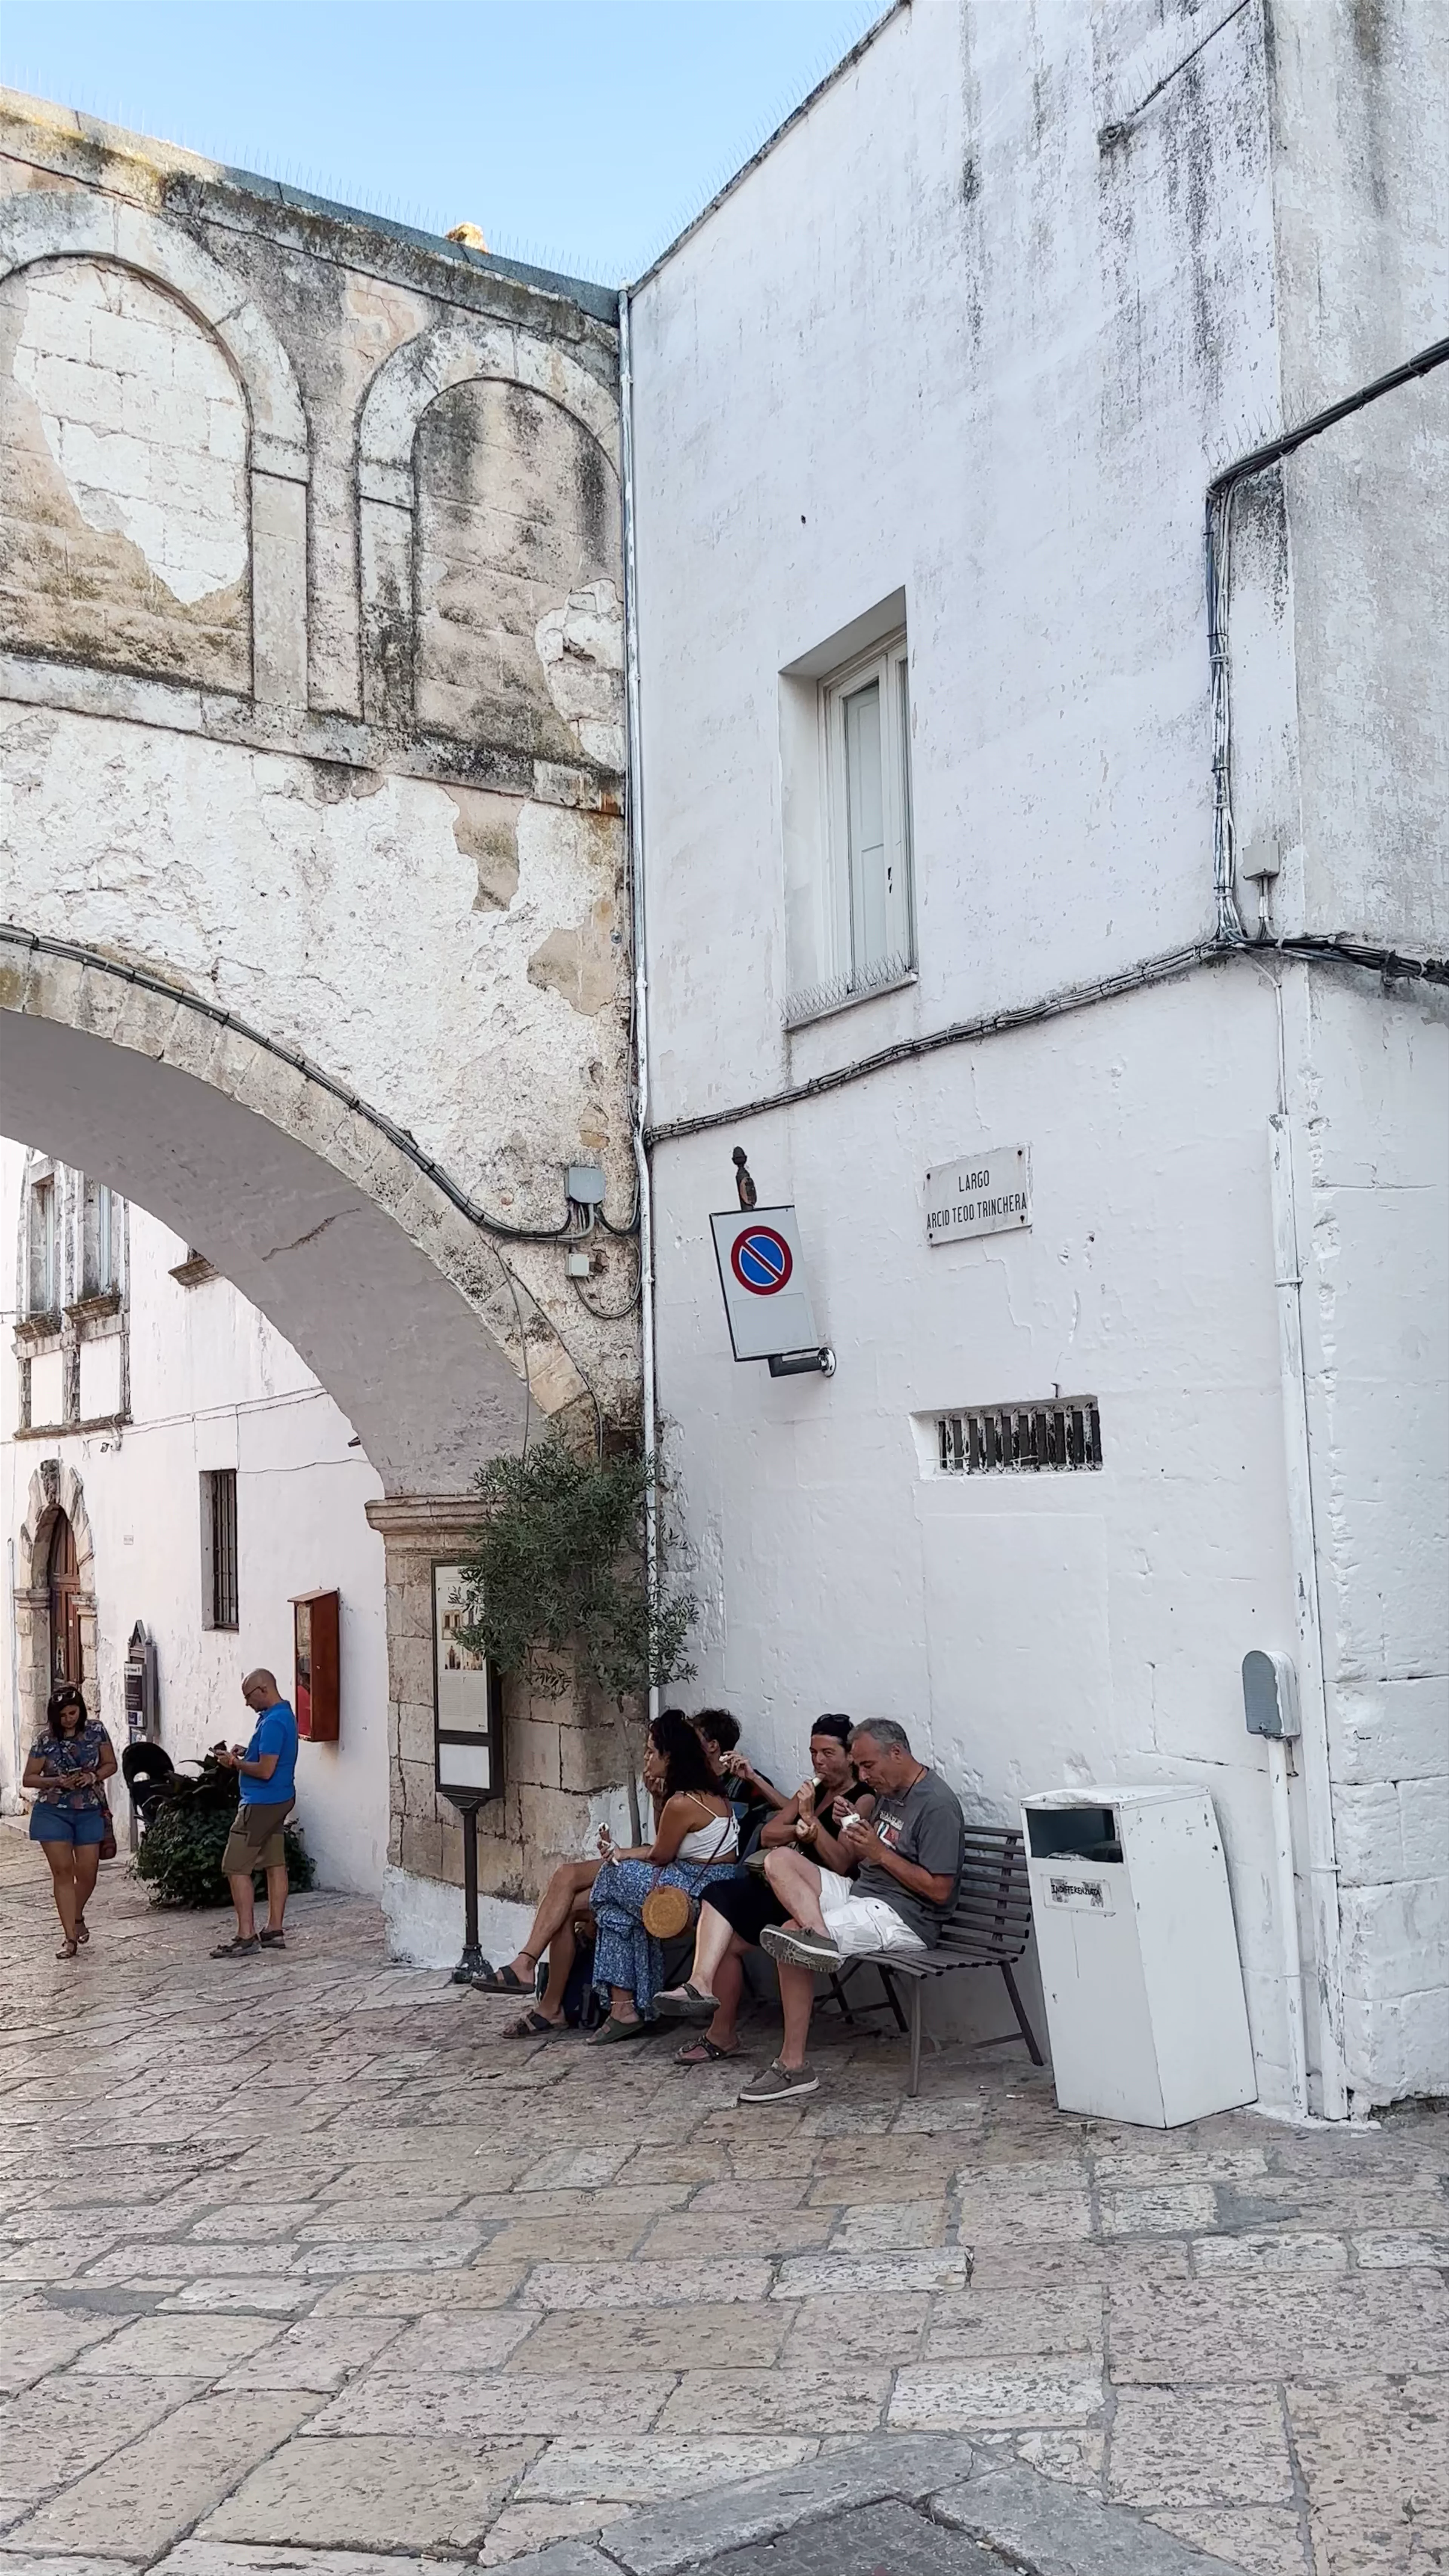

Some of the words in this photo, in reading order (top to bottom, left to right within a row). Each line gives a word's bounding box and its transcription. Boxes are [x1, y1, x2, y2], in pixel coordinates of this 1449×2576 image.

[958, 1170, 989, 1192] LARGO
[927, 1209, 950, 1230] ARCID
[977, 1192, 1027, 1218] TRINCHERA
